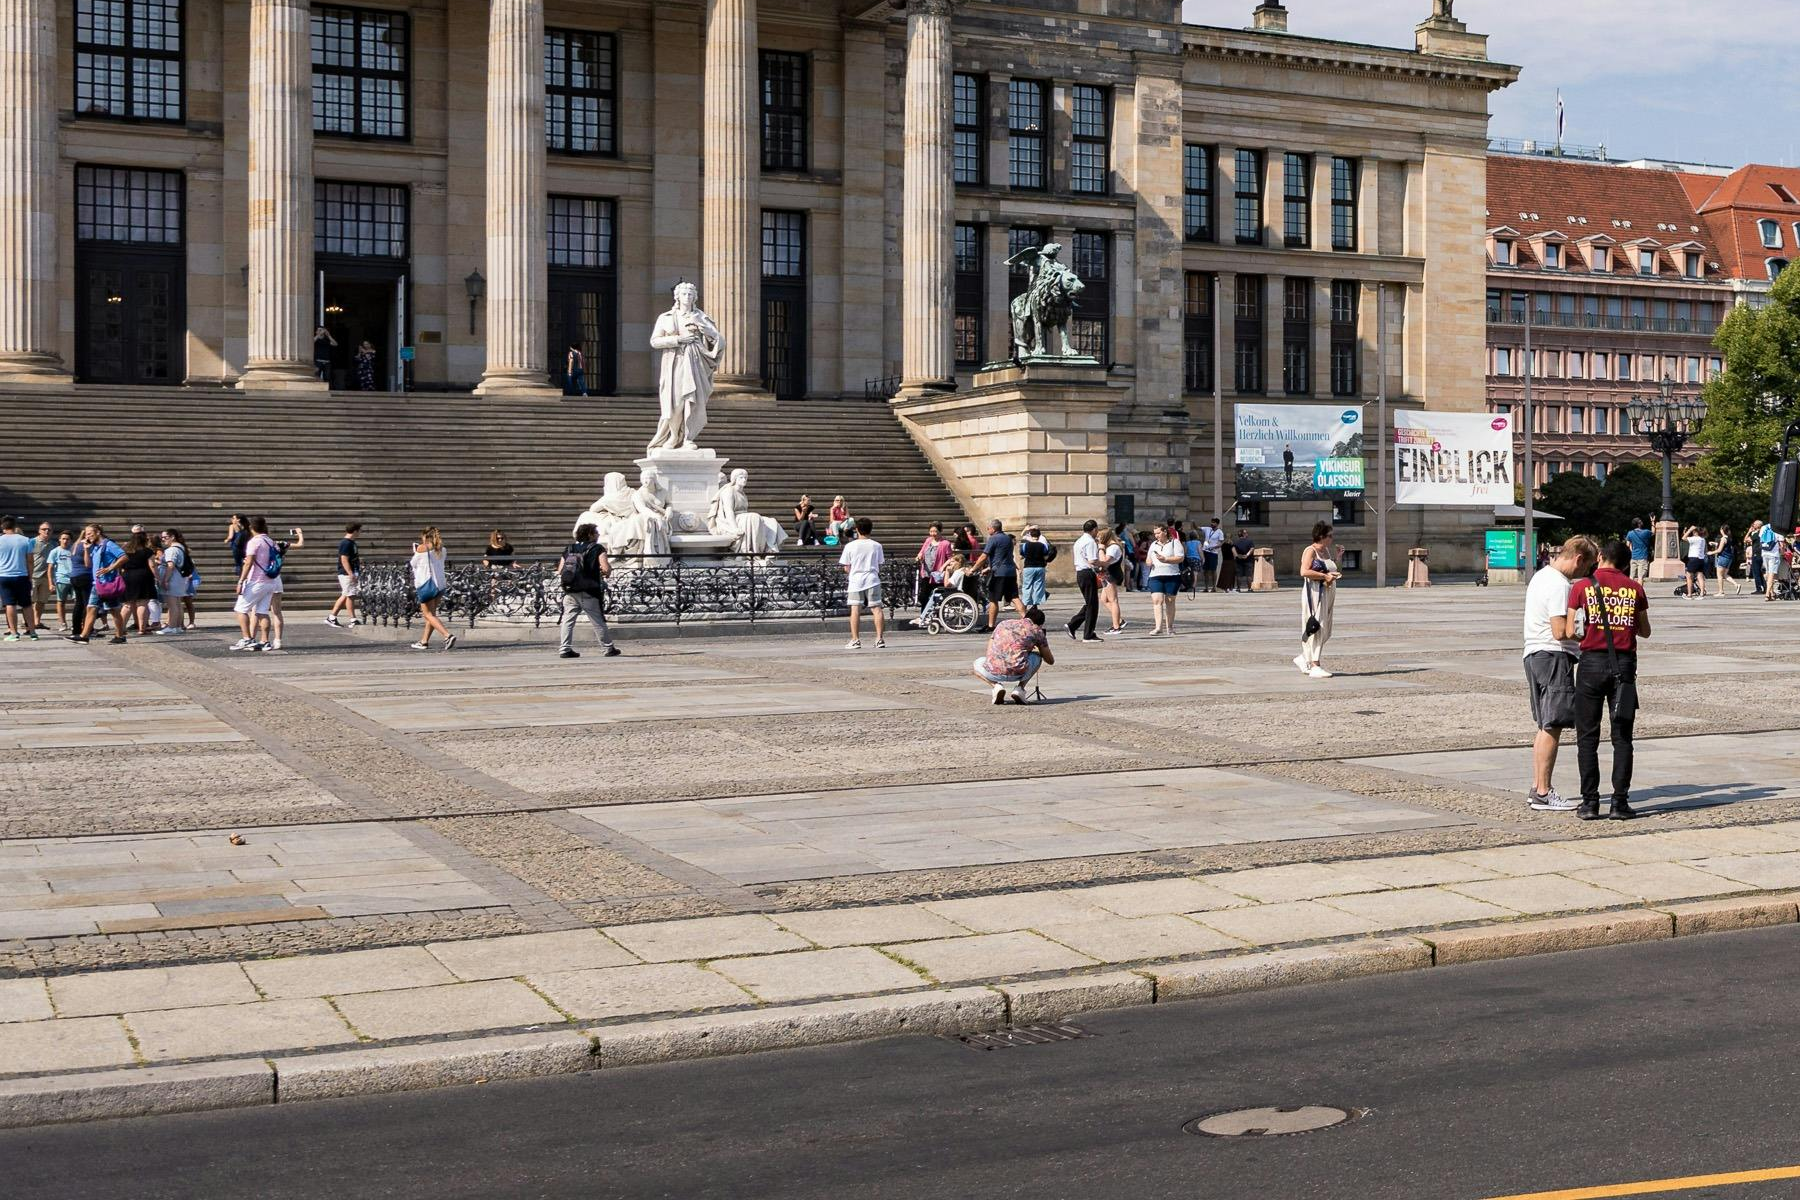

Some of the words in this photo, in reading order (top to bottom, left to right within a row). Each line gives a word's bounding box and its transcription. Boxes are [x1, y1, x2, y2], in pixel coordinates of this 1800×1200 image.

[1238, 415, 1270, 427] Velkom
[1271, 417, 1279, 427] &
[1239, 428, 1274, 441] Herzlich
[1275, 429, 1330, 441] Willkommen
[1398, 447, 1510, 484] EINBLICK
[1317, 472, 1361, 487] ÓLAFSSON
[1584, 586, 1637, 599] HP-ON
[1586, 596, 1636, 607] DICOVER
[1588, 614, 1634, 626] EXLORE
